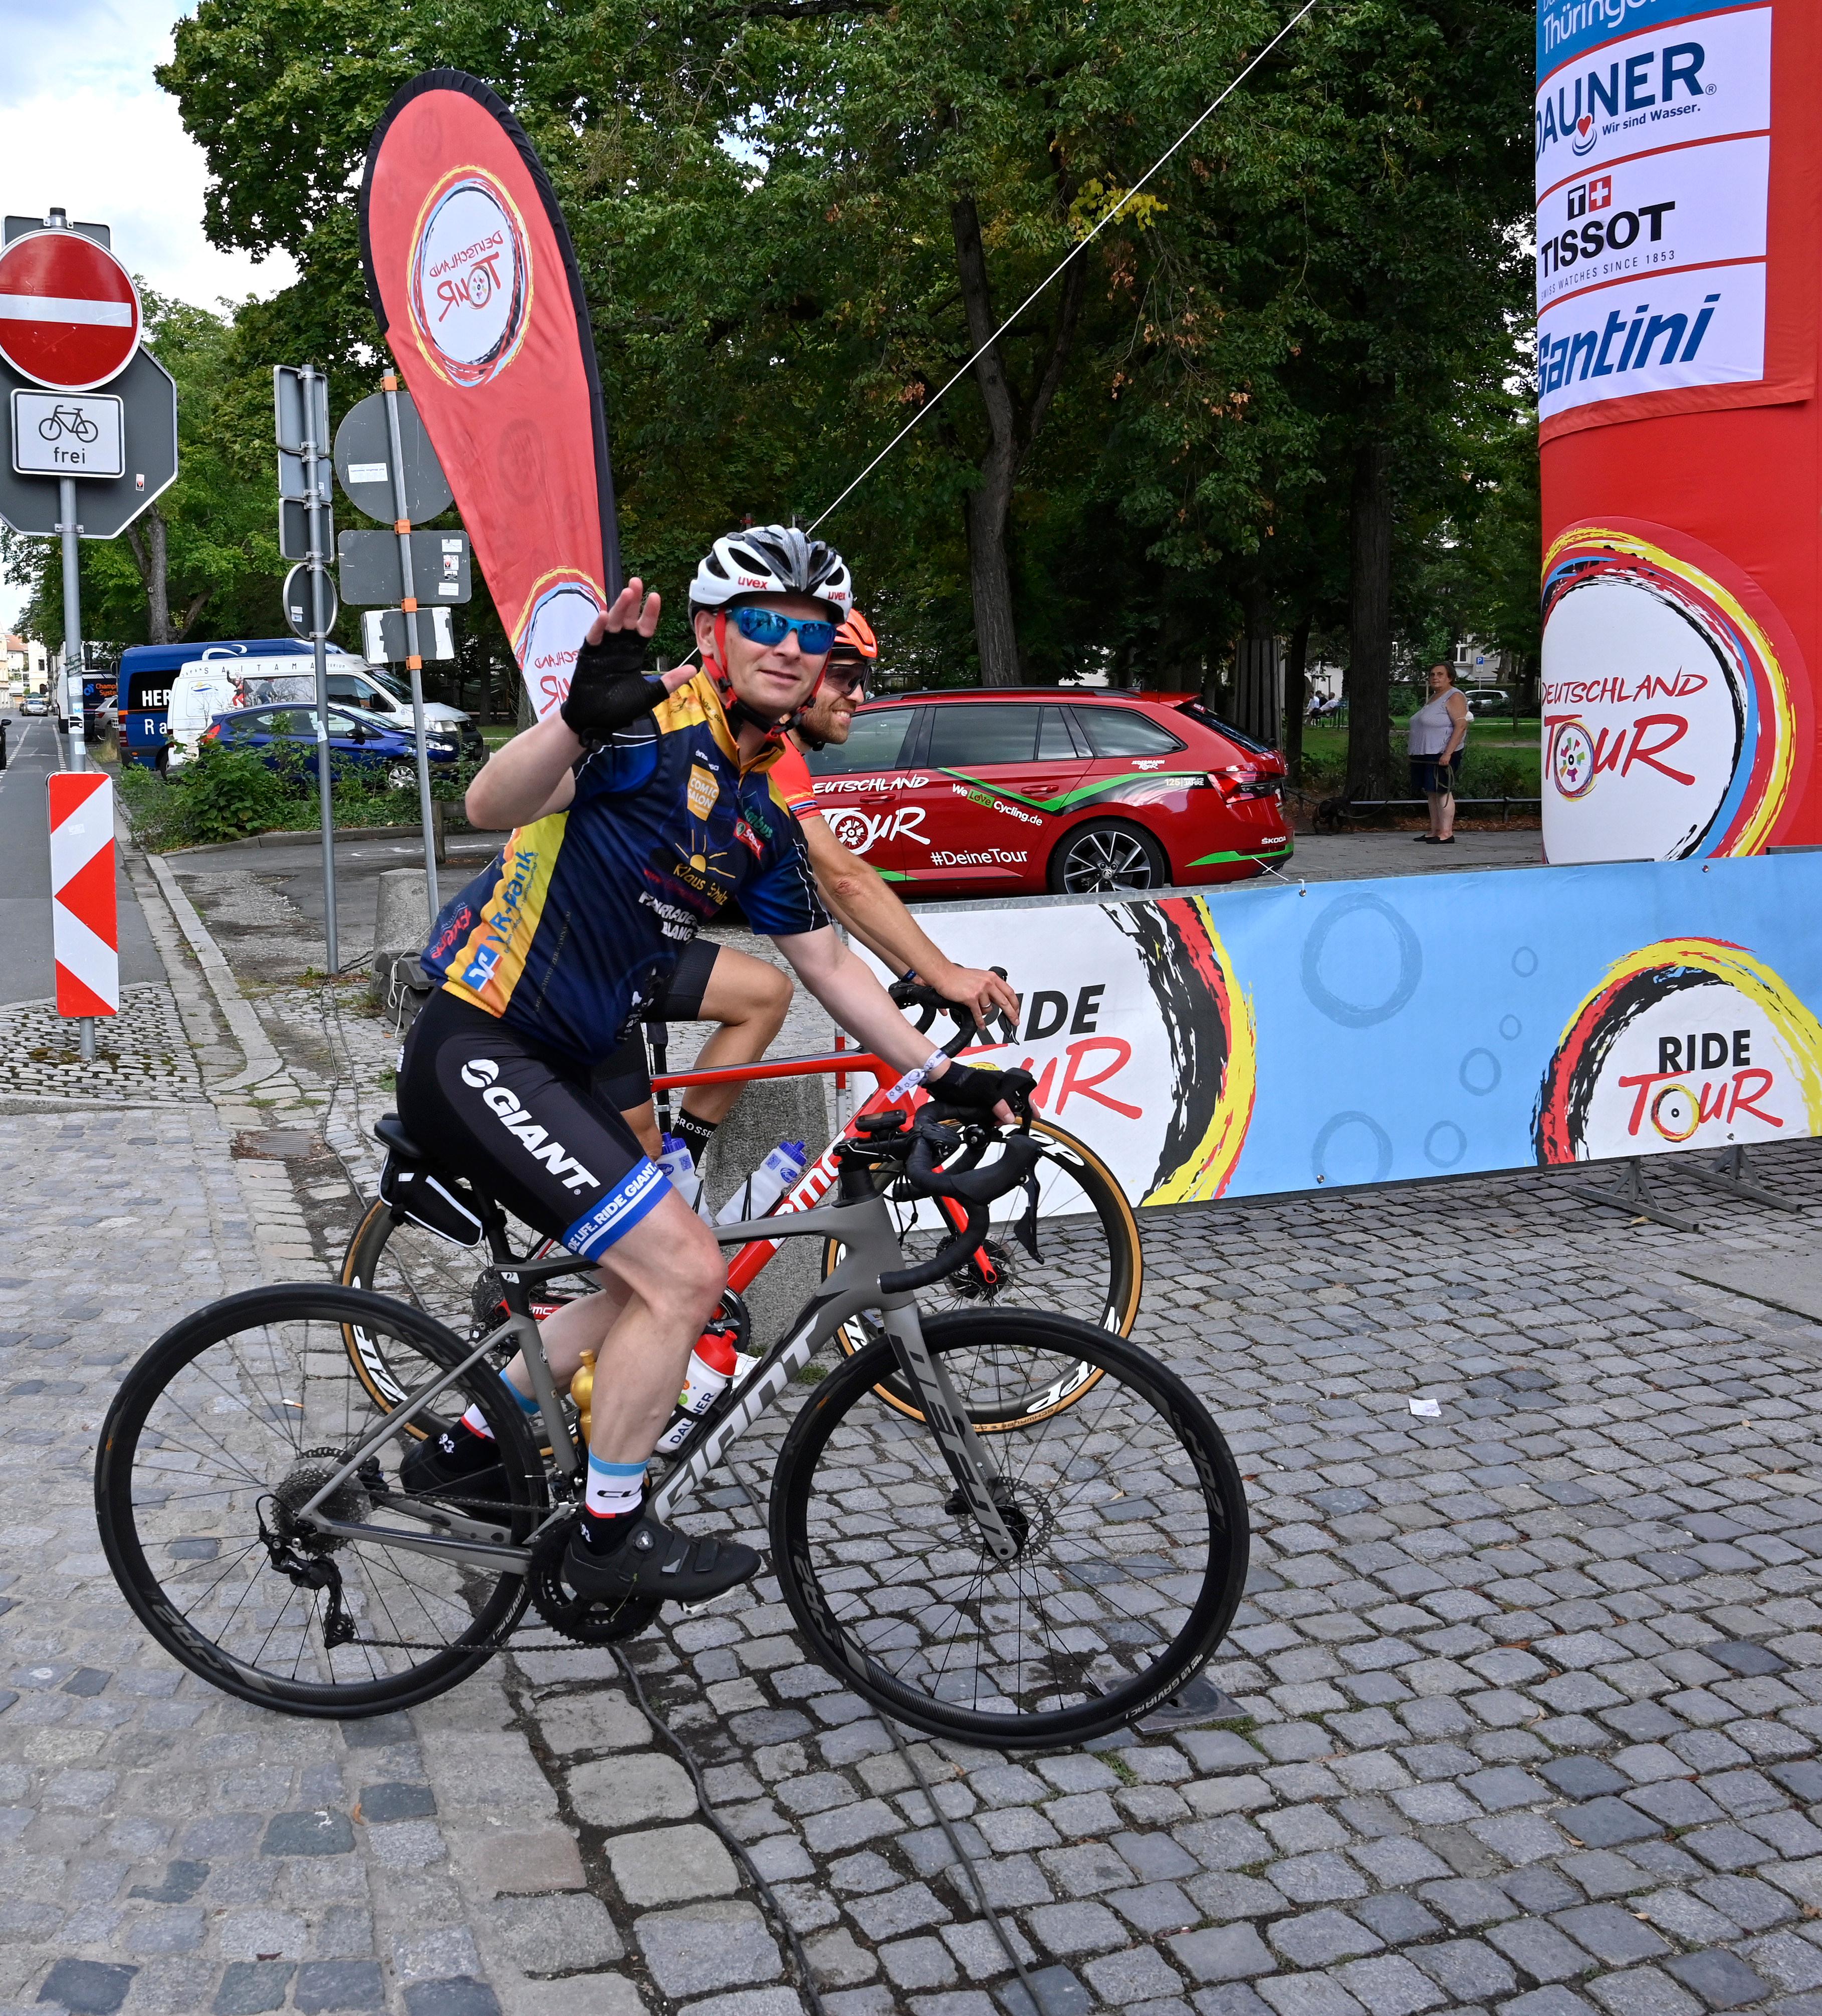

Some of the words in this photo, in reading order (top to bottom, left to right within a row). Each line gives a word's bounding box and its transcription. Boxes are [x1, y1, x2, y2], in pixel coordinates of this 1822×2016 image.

[1603, 122, 1621, 136] Wir
[1623, 113, 1646, 129] sind
[1651, 104, 1701, 122] Wasser.
[1541, 200, 1676, 279] TISSOT
[1541, 284, 1555, 301] SWISS
[1558, 268, 1597, 290] WATCHES
[1604, 257, 1638, 274] SINCE
[1646, 250, 1675, 265] 1853
[1538, 293, 1721, 401] Santini
[53, 447, 86, 464] frei
[738, 576, 768, 590] uvex
[828, 591, 846, 601] uvex
[1541, 665, 1708, 707] DEUTSCHLAND
[1544, 713, 1695, 801] TOUR
[690, 778, 718, 799] COMIC
[812, 774, 929, 794] EUTSCHLAND
[1165, 778, 1181, 786] 125
[688, 789, 714, 809] SALON
[952, 783, 968, 797] We
[994, 801, 1043, 827] Cycling.de
[1261, 836, 1286, 845] ŠKODA
[930, 849, 1028, 867] #DeineTour
[673, 863, 706, 890] Klaus
[1659, 1030, 1750, 1073] RIDE
[1618, 1068, 1783, 1142] TOUR
[574, 1221, 599, 1242] LIFE.
[593, 1193, 628, 1223] RIDE
[624, 1162, 657, 1198] GIANT.
[1143, 1678, 1181, 1710] GAVIA
